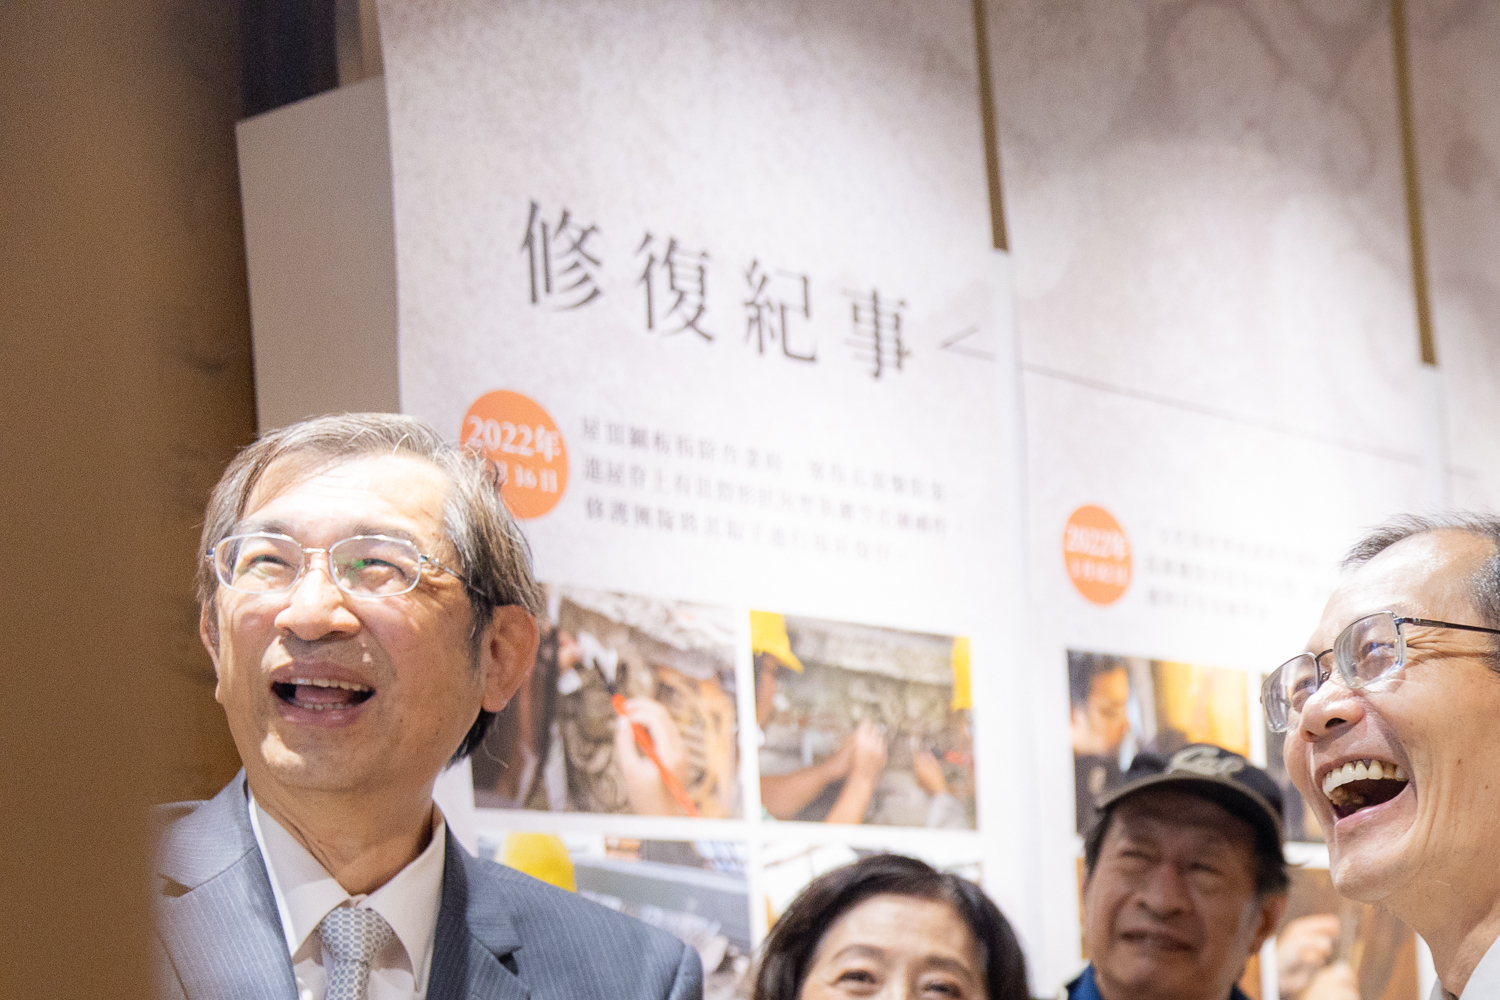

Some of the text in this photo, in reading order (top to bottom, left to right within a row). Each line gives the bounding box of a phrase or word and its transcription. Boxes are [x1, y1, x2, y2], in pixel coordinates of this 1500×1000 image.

[520, 199, 914, 380] 修復紀事
[465, 414, 561, 463] 2022年
